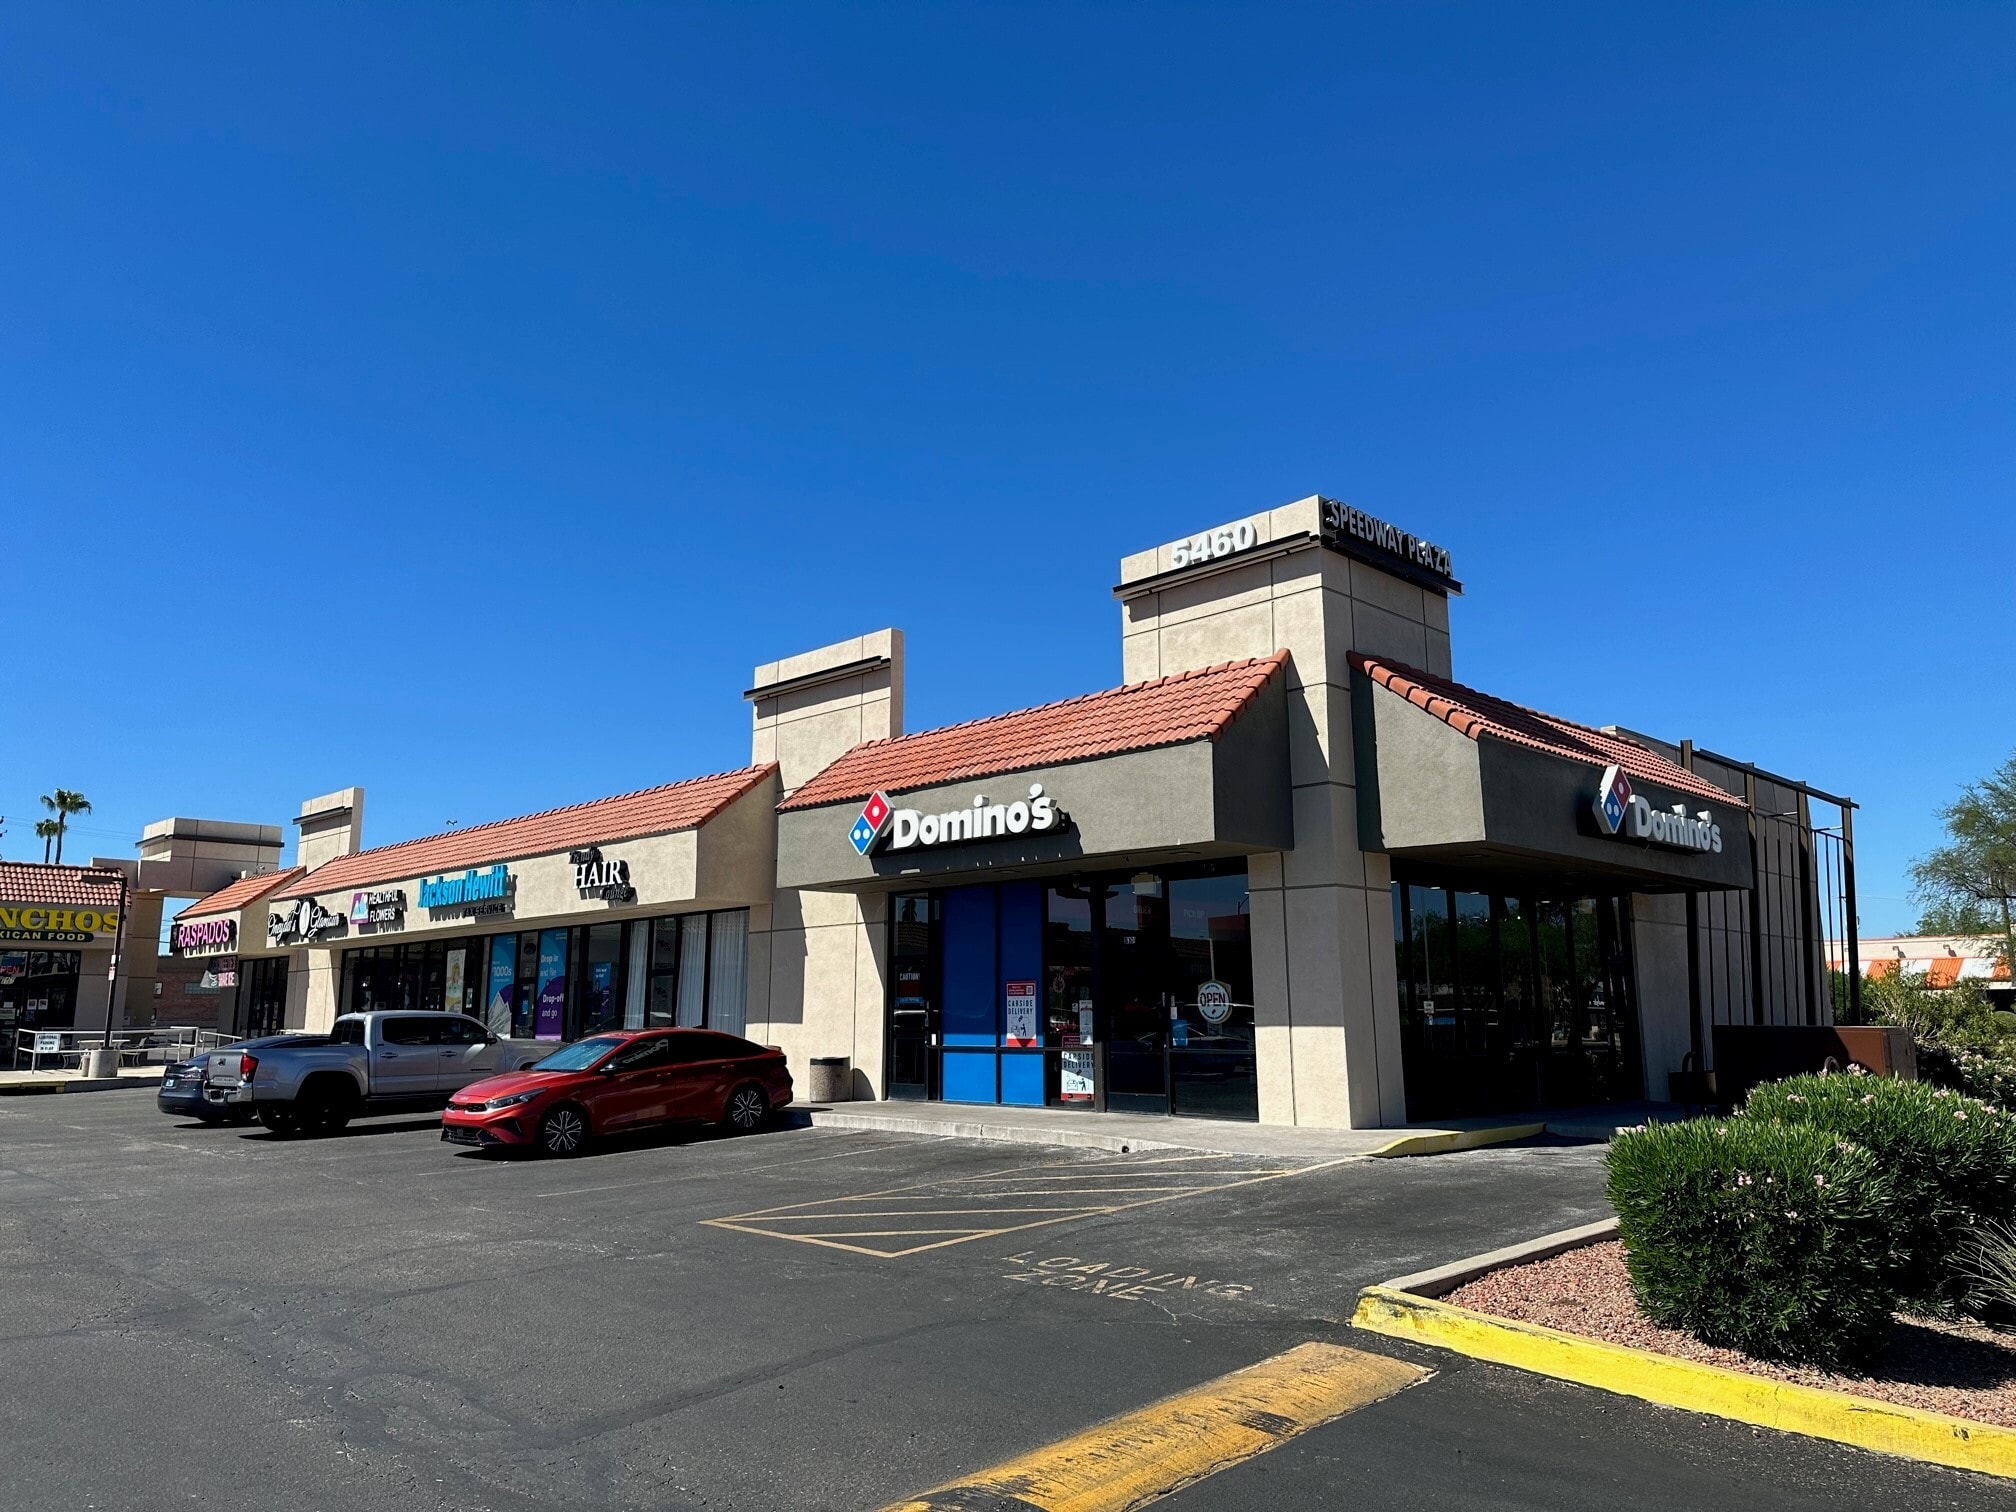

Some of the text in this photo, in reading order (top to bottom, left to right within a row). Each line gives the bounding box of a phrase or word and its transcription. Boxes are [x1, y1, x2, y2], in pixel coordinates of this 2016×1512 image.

[1171, 520, 1256, 569] 5460
[1331, 499, 1453, 577] SPEEDWAY PLAZA
[893, 783, 1057, 850] Domino's
[1631, 795, 1723, 855] Domino's
[418, 864, 508, 908] Jackson Hewitt
[572, 860, 623, 890] HAIR
[368, 890, 399, 905] HEALTHFUL
[47, 932, 86, 941] FOOD
[178, 919, 230, 948] RASPADOS
[541, 954, 553, 965] Drop
[899, 973, 920, 981] CAUTION!
[543, 993, 565, 1004] Drop-off
[1200, 992, 1226, 1007] OPEN
[541, 1009, 558, 1019] and go
[1063, 1061, 1094, 1069] DELIVERY
[1001, 1250, 1254, 1299] LOADING
[1001, 1267, 1167, 1302] ZONE
